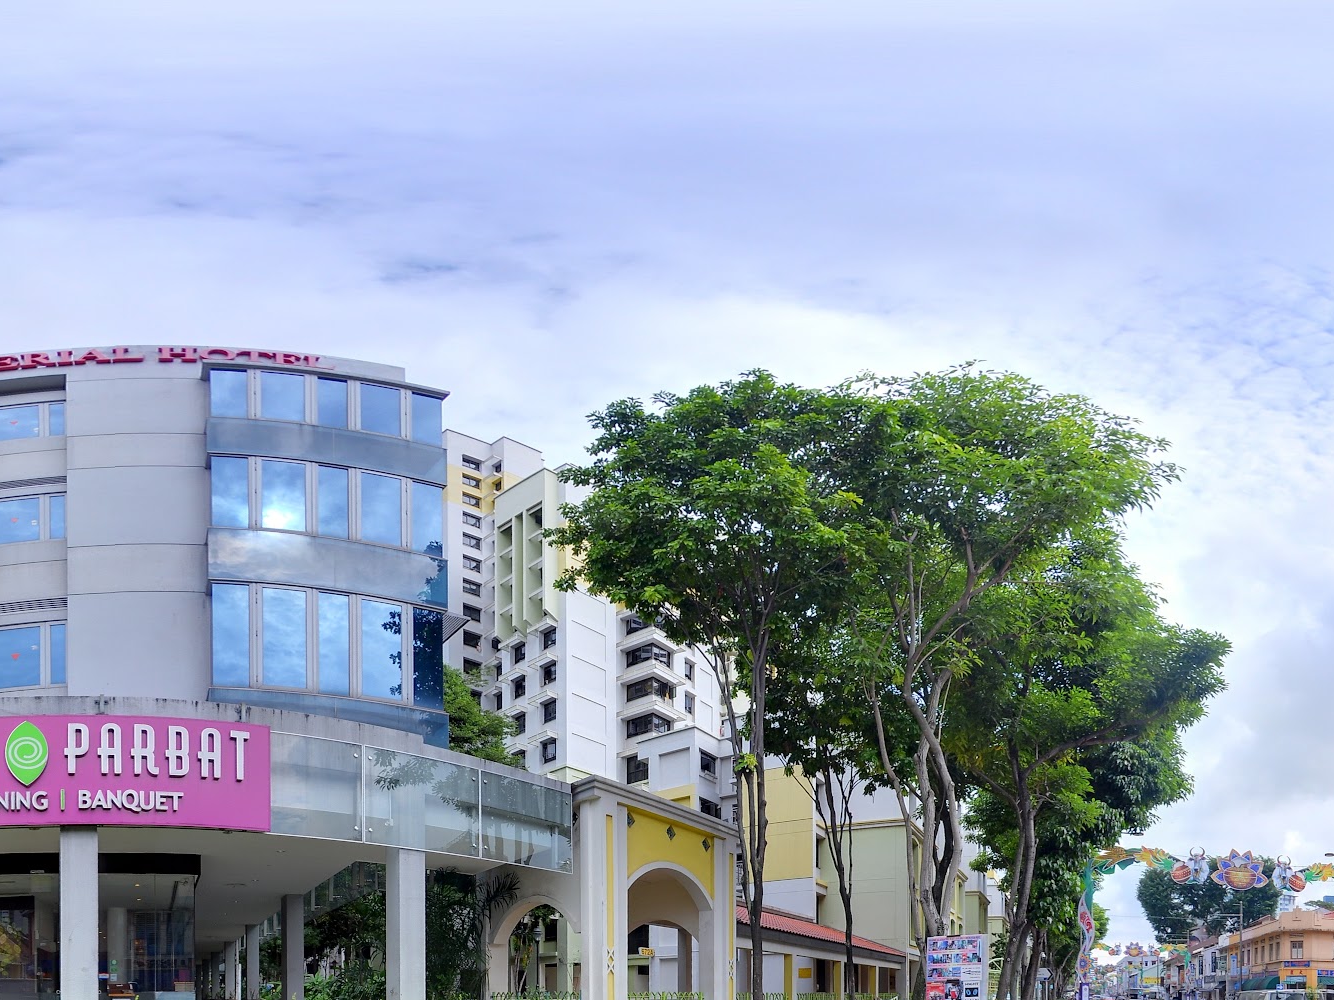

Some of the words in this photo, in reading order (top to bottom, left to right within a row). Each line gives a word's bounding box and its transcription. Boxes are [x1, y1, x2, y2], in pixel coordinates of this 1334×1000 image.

[158, 347, 336, 370] HOTEL
[64, 722, 250, 781] PARBAT
[78, 789, 184, 812] BANQUET
